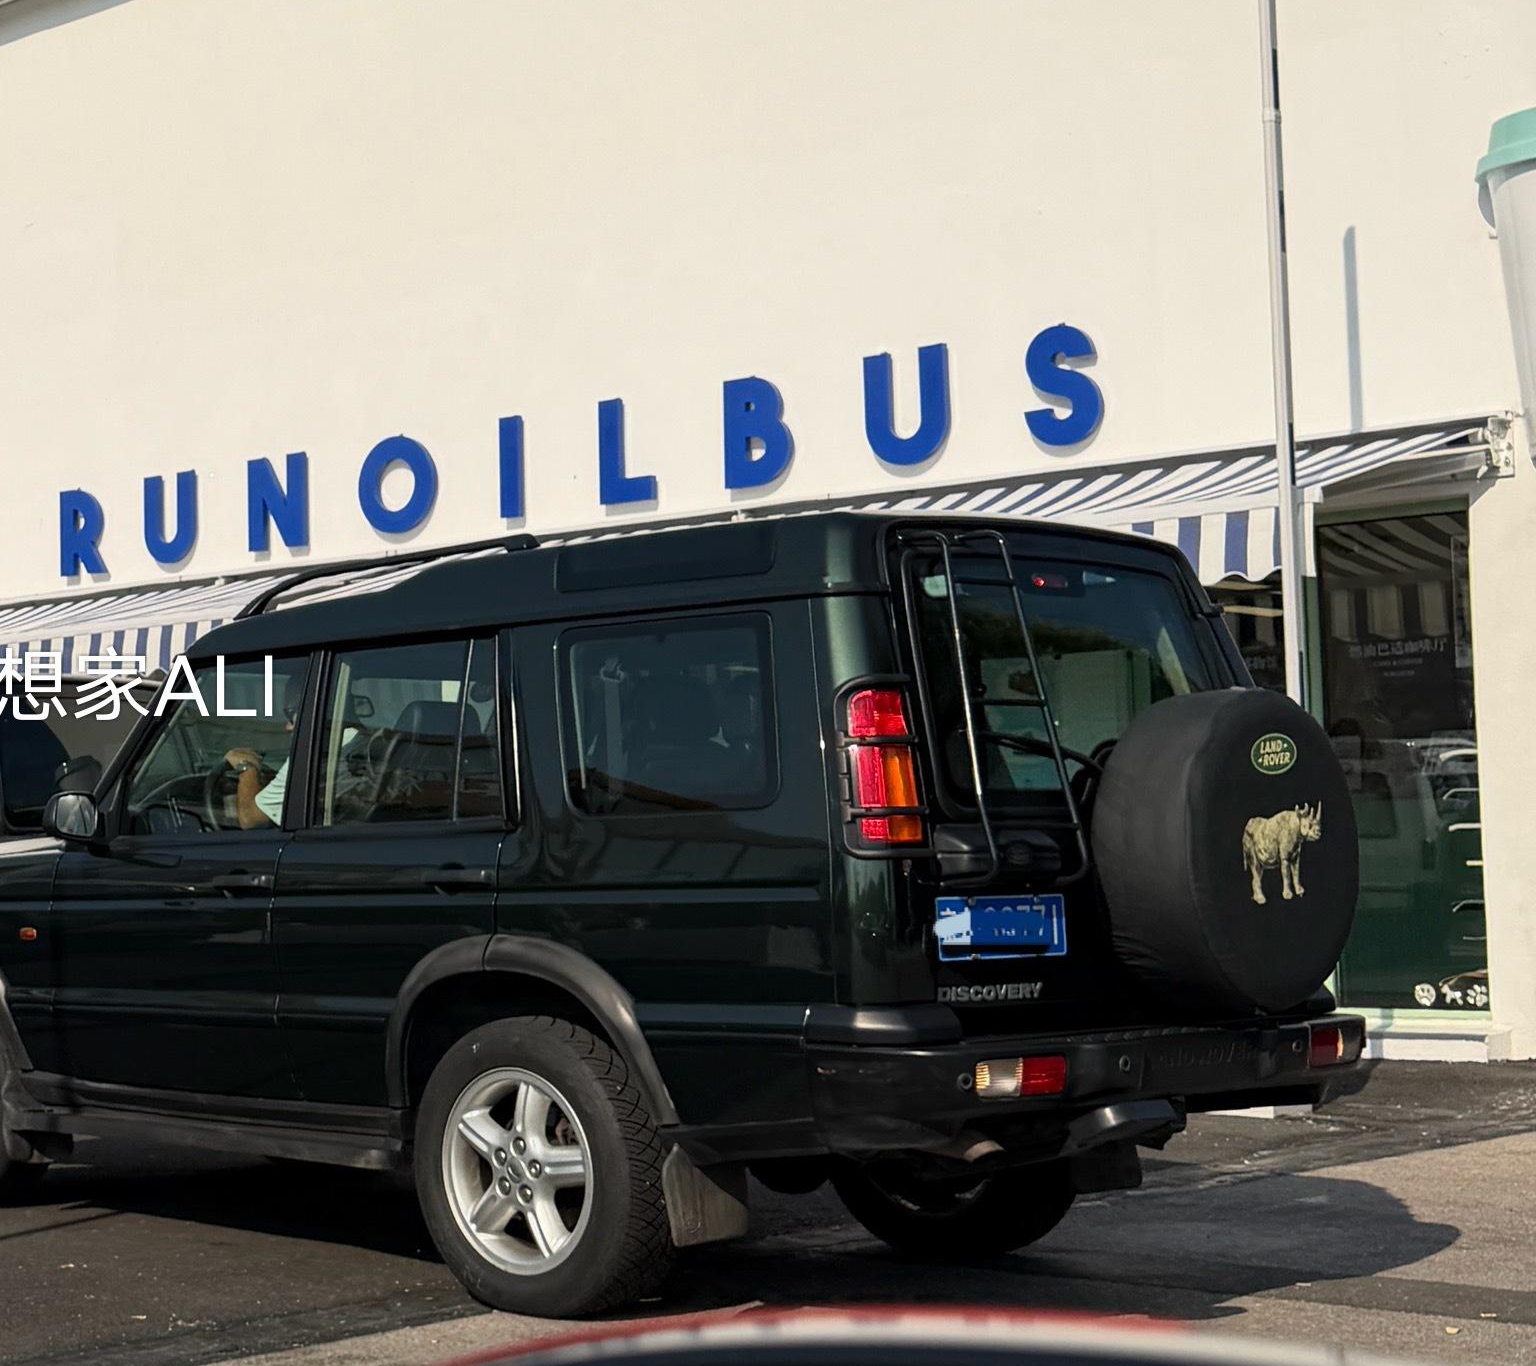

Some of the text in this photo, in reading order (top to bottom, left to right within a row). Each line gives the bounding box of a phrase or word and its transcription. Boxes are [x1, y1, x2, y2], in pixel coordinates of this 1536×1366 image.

[59, 323, 1105, 577] RUNOILBUS
[1260, 739, 1283, 754] LAND
[1262, 752, 1291, 766] ROVER
[936, 982, 1044, 1002] DISCOVERY
